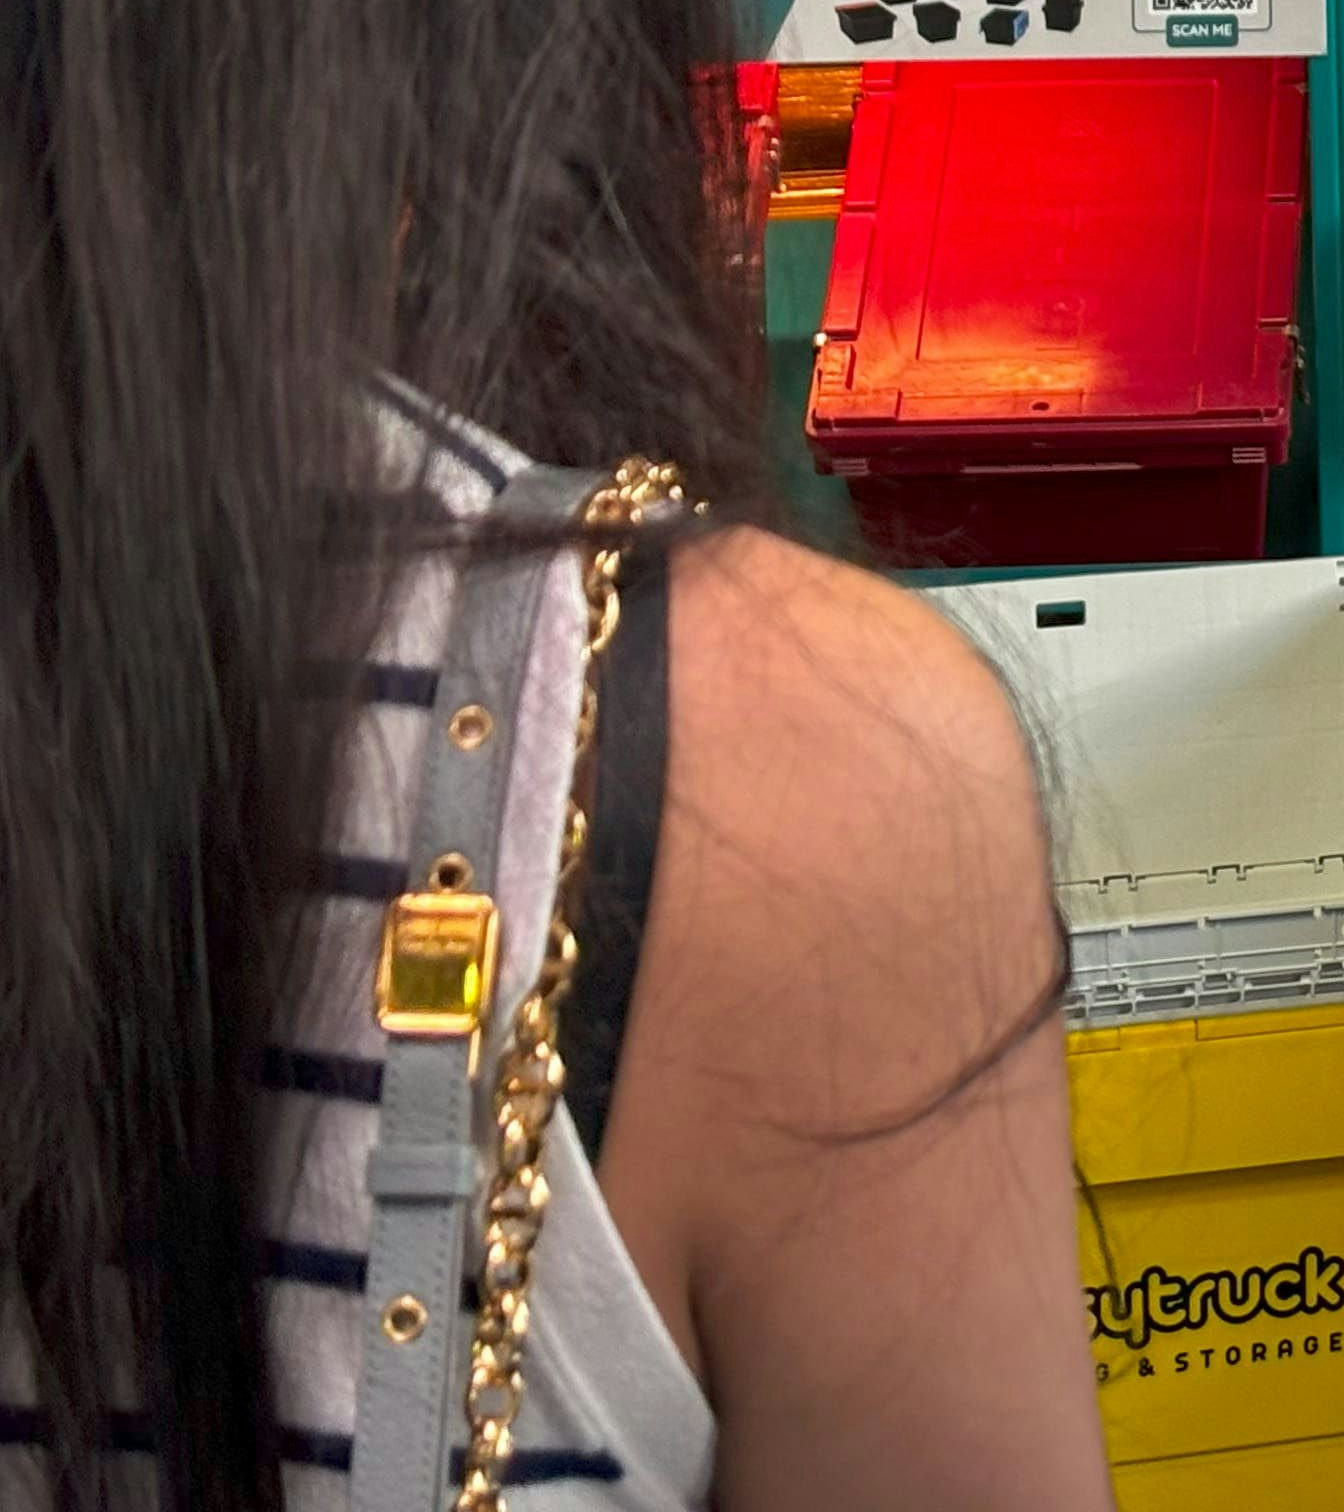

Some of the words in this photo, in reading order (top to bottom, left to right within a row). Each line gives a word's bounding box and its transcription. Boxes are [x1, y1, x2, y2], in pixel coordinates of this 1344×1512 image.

[1172, 23, 1209, 37] SCAN
[1212, 23, 1233, 36] ME
[1138, 1357, 1155, 1377] &
[1175, 1332, 1344, 1372] STORAGE
